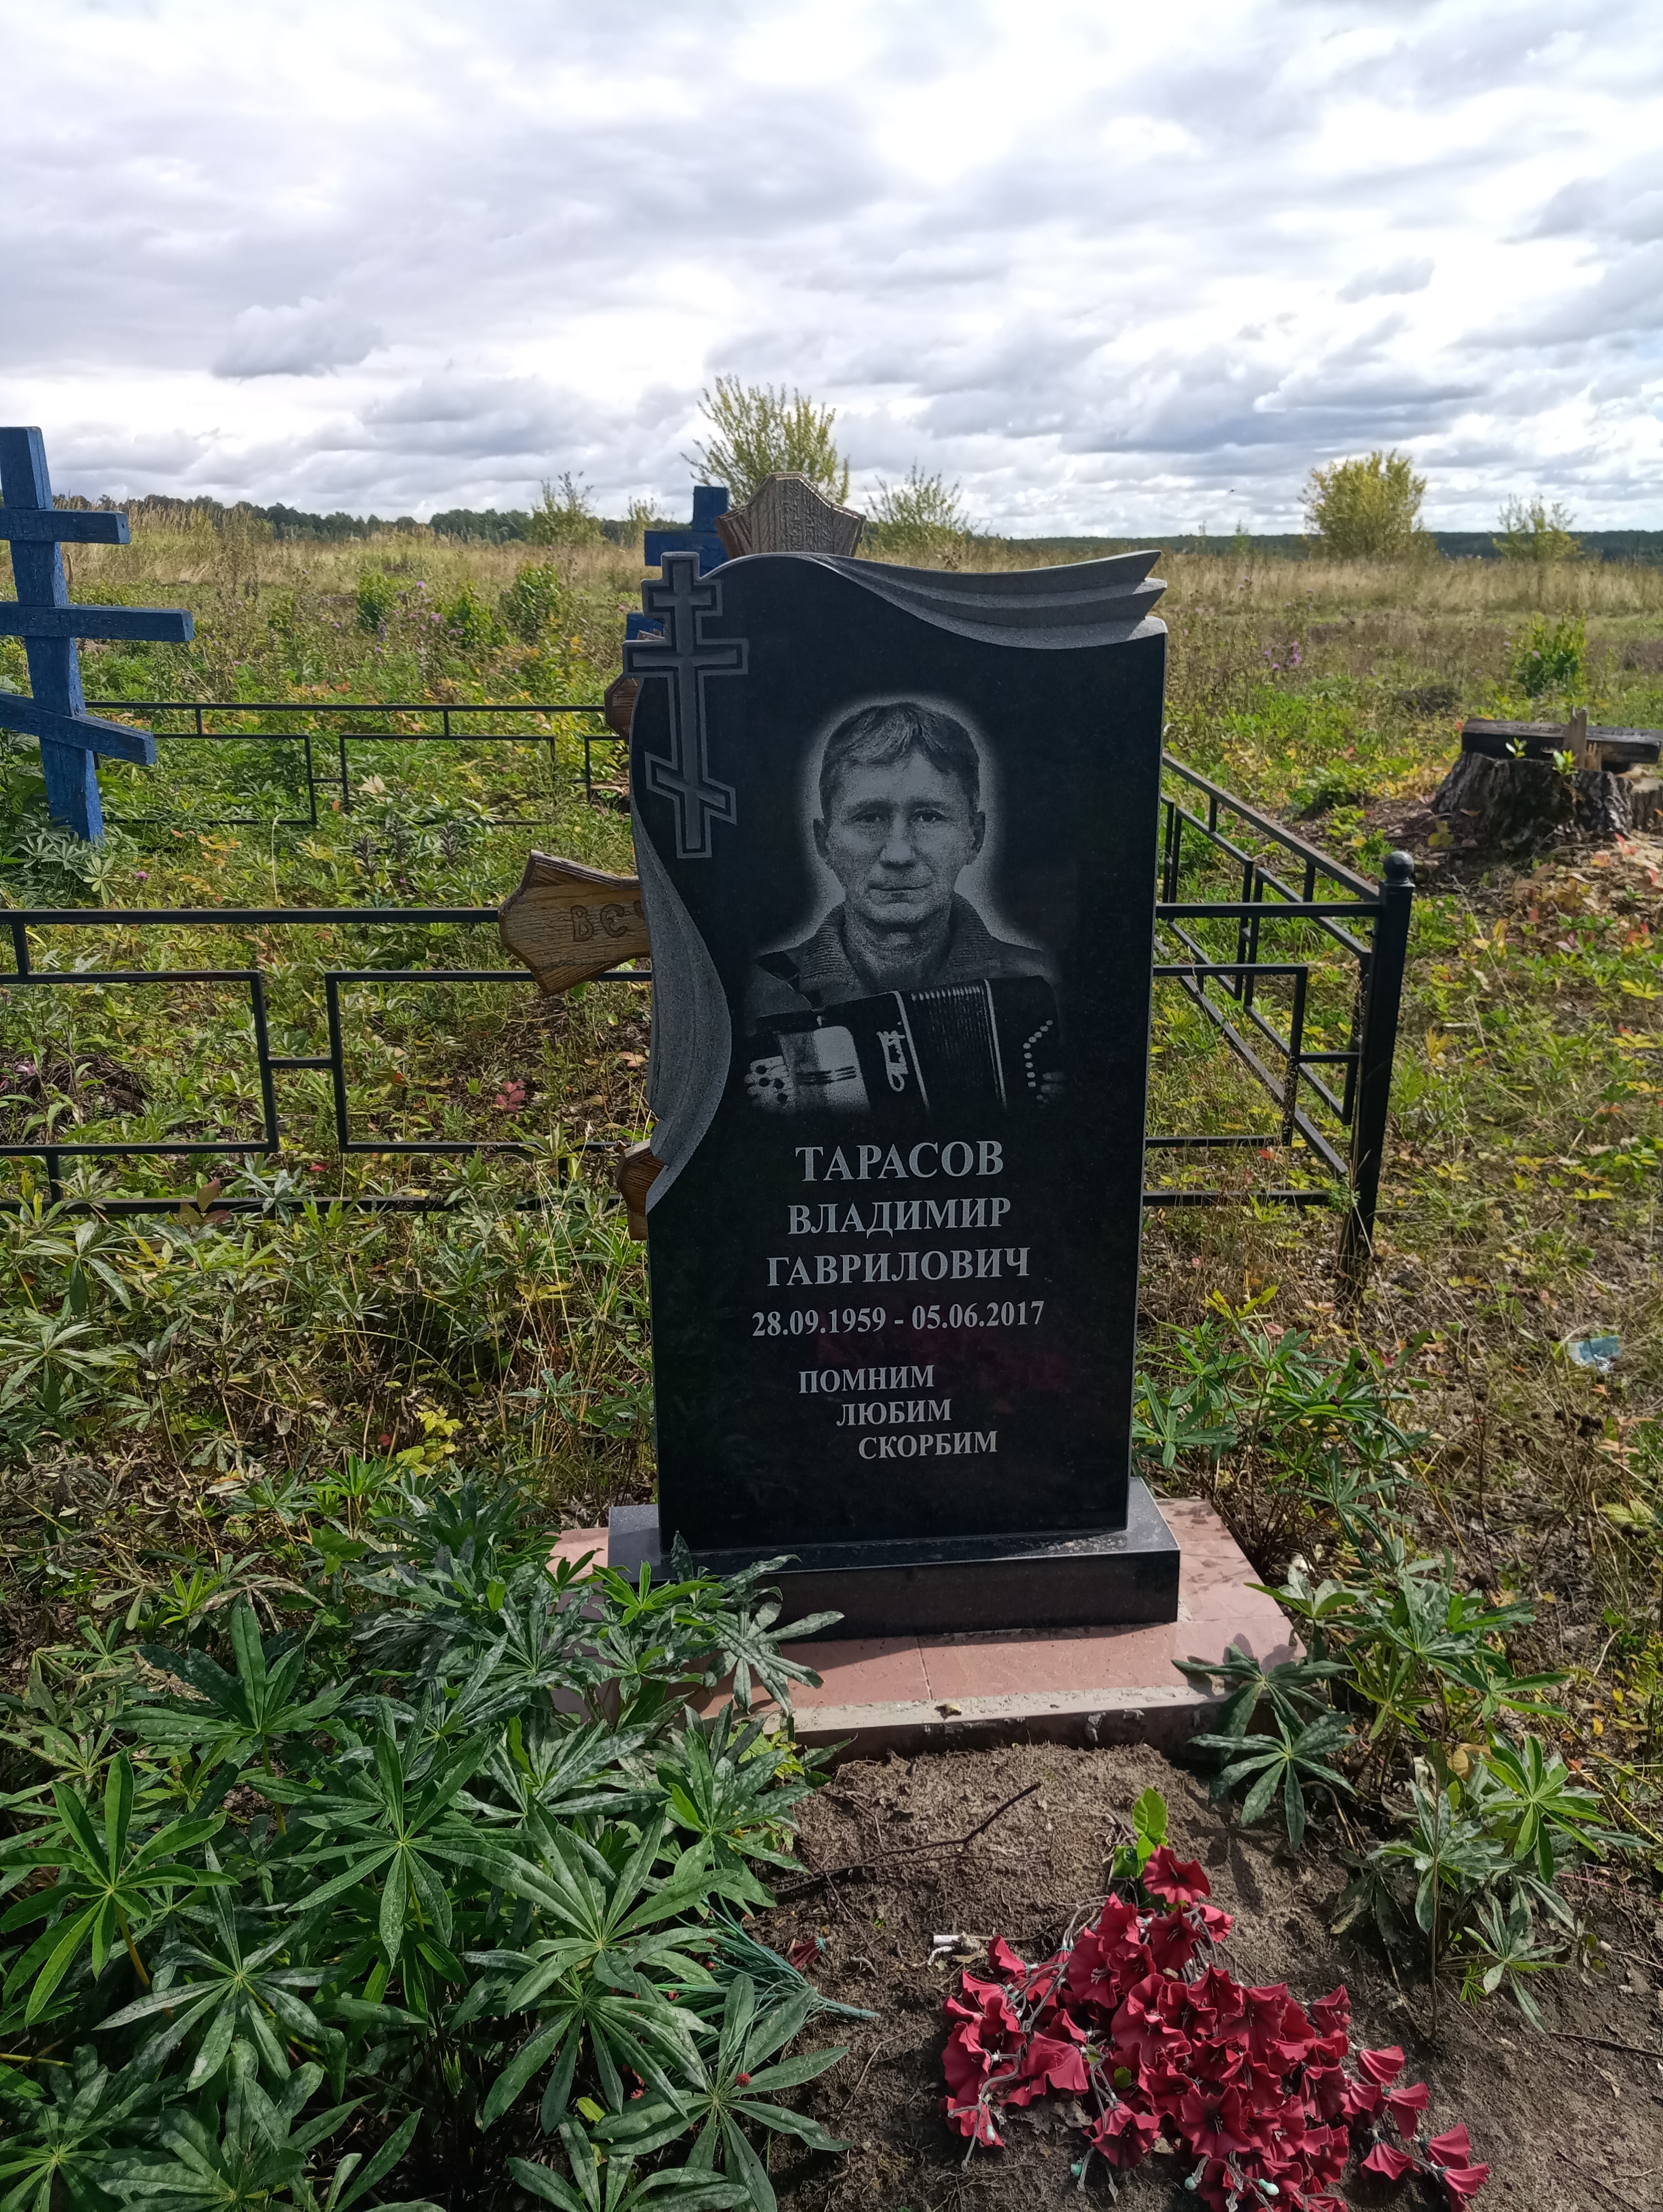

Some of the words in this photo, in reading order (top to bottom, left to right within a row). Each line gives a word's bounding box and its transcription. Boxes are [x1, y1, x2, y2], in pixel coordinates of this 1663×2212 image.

[795, 1140, 1004, 1182] ТАРАСОВ
[787, 1197, 1011, 1239] ВЛАДИМИР
[766, 1247, 1031, 1287] ГАВРИЛОВИЧ
[752, 1306, 886, 1337] 28.09.1959
[912, 1300, 1045, 1330] 05.06.2017
[798, 1364, 935, 1394] ПОМНИМ
[836, 1399, 952, 1426] ЛЮБИМ
[859, 1430, 998, 1459] СКОРБИМ
